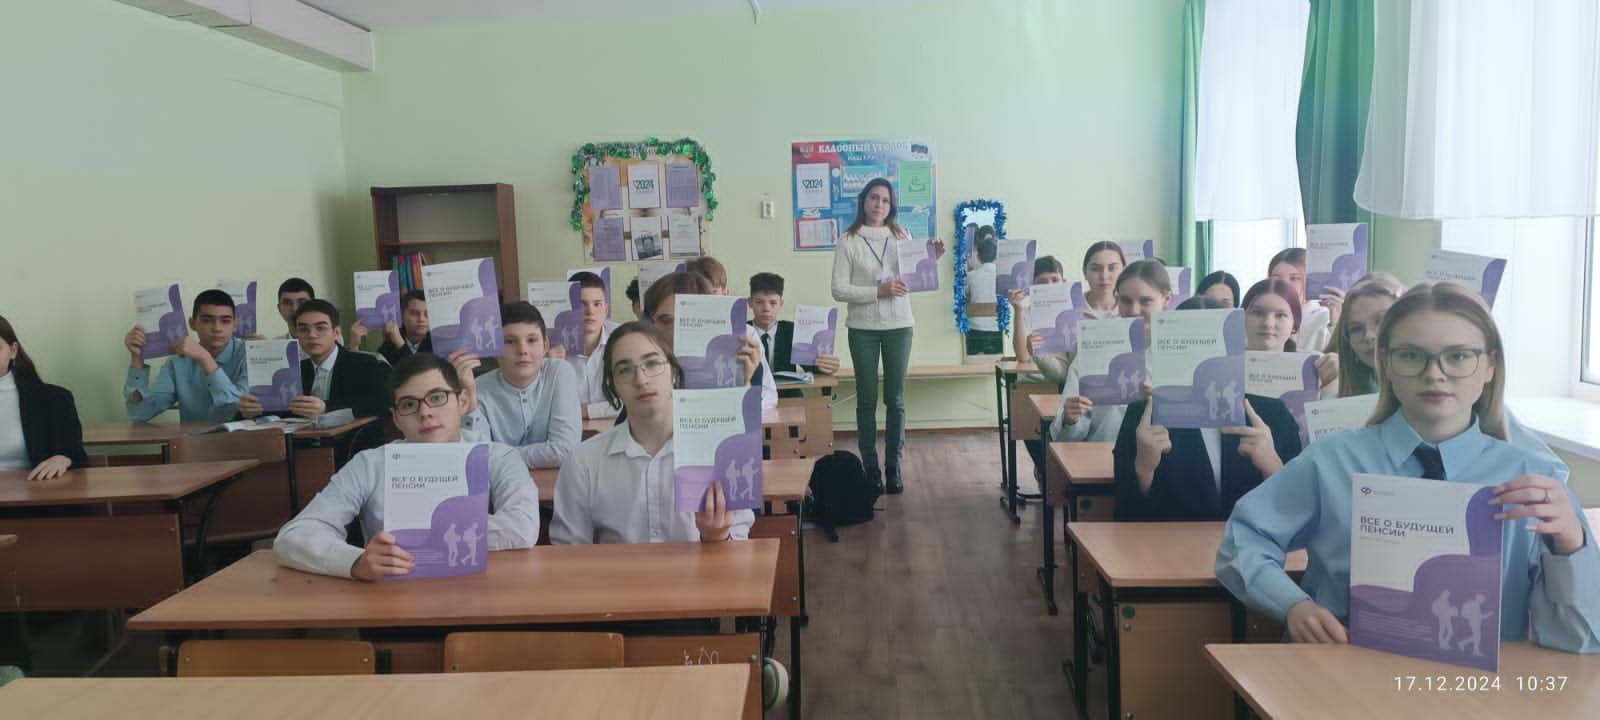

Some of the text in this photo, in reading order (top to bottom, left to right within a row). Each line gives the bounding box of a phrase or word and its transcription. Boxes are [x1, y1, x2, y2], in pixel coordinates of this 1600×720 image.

[636, 179, 655, 190] 2024
[418, 475, 458, 483] БУДУЩЕЙ
[1360, 515, 1454, 535] ВСЕ О БУДУЩЕЙ
[1360, 524, 1405, 537] ПЕНСИИ
